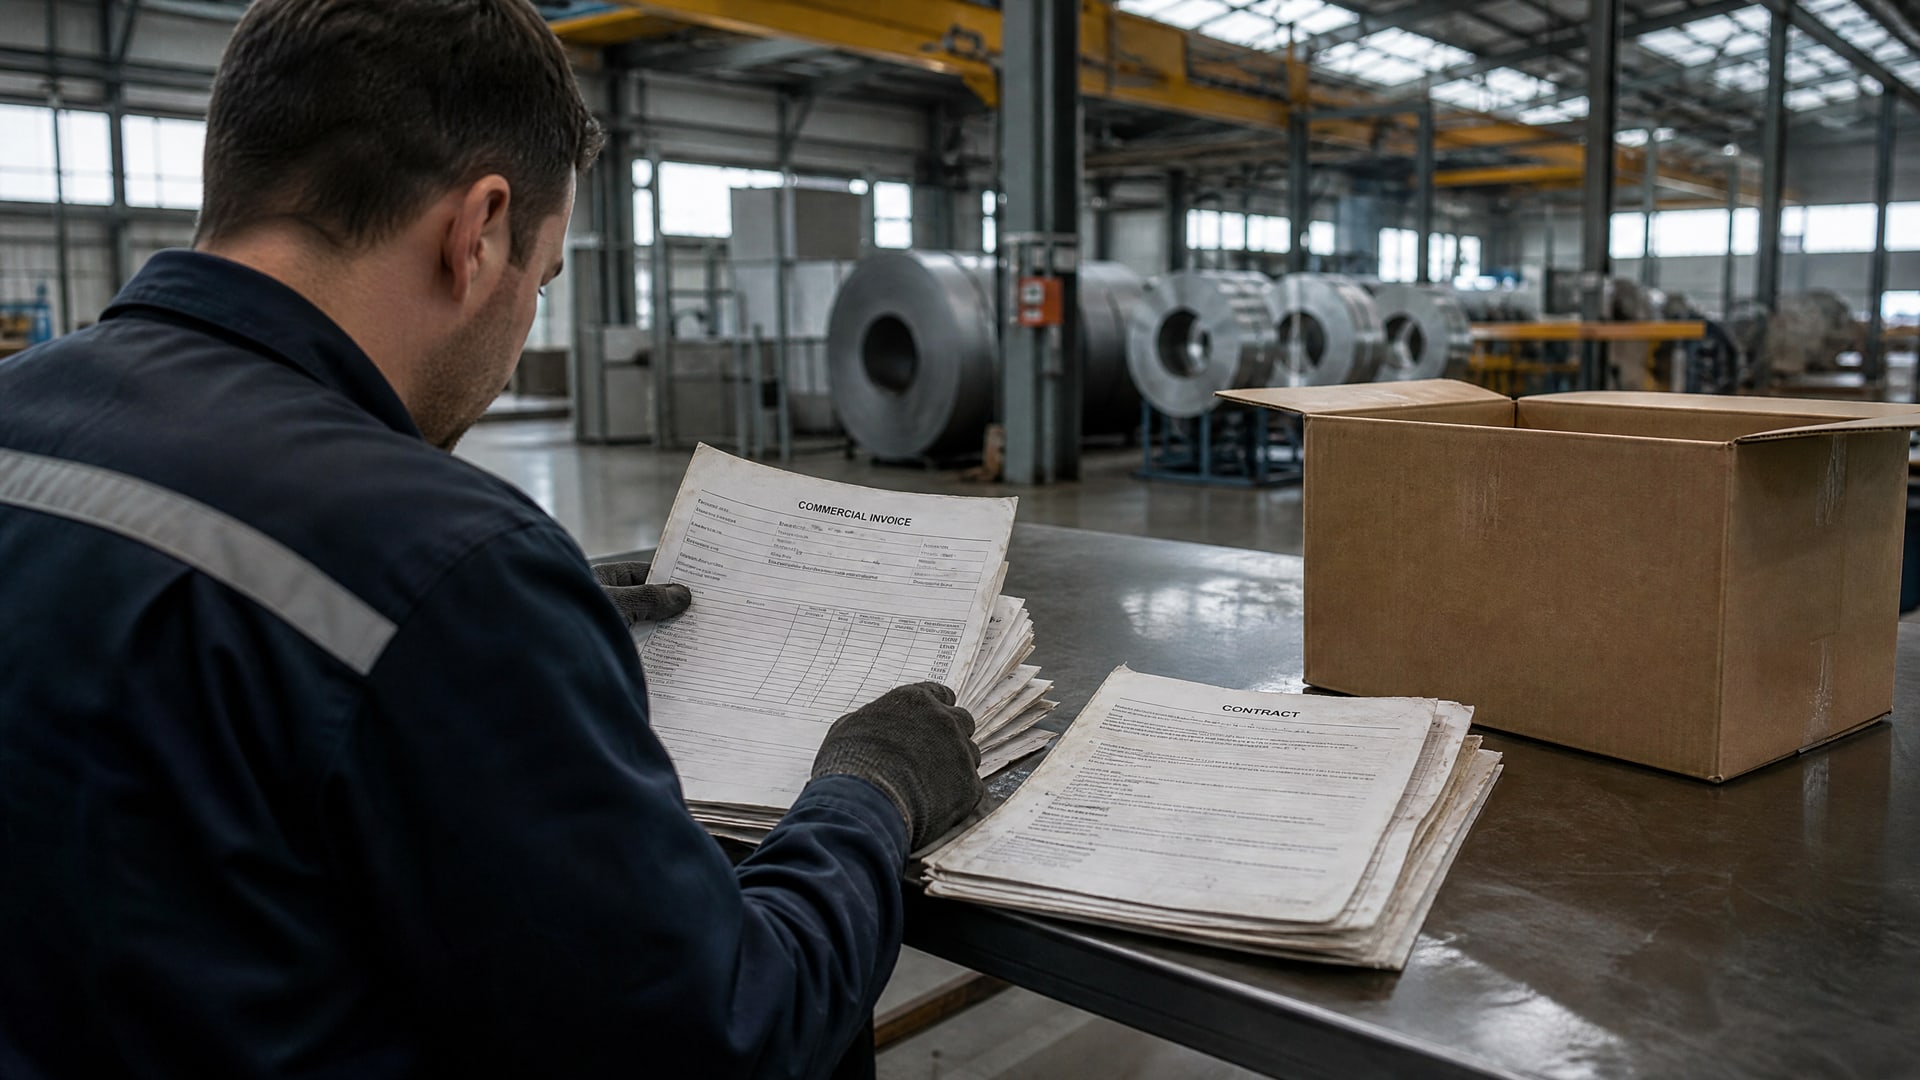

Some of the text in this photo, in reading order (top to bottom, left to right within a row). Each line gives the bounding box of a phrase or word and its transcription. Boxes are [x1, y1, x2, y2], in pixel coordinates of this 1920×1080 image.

[798, 500, 912, 527] COMMERCIAL INVOICE
[1222, 704, 1301, 719] CONTRACT
